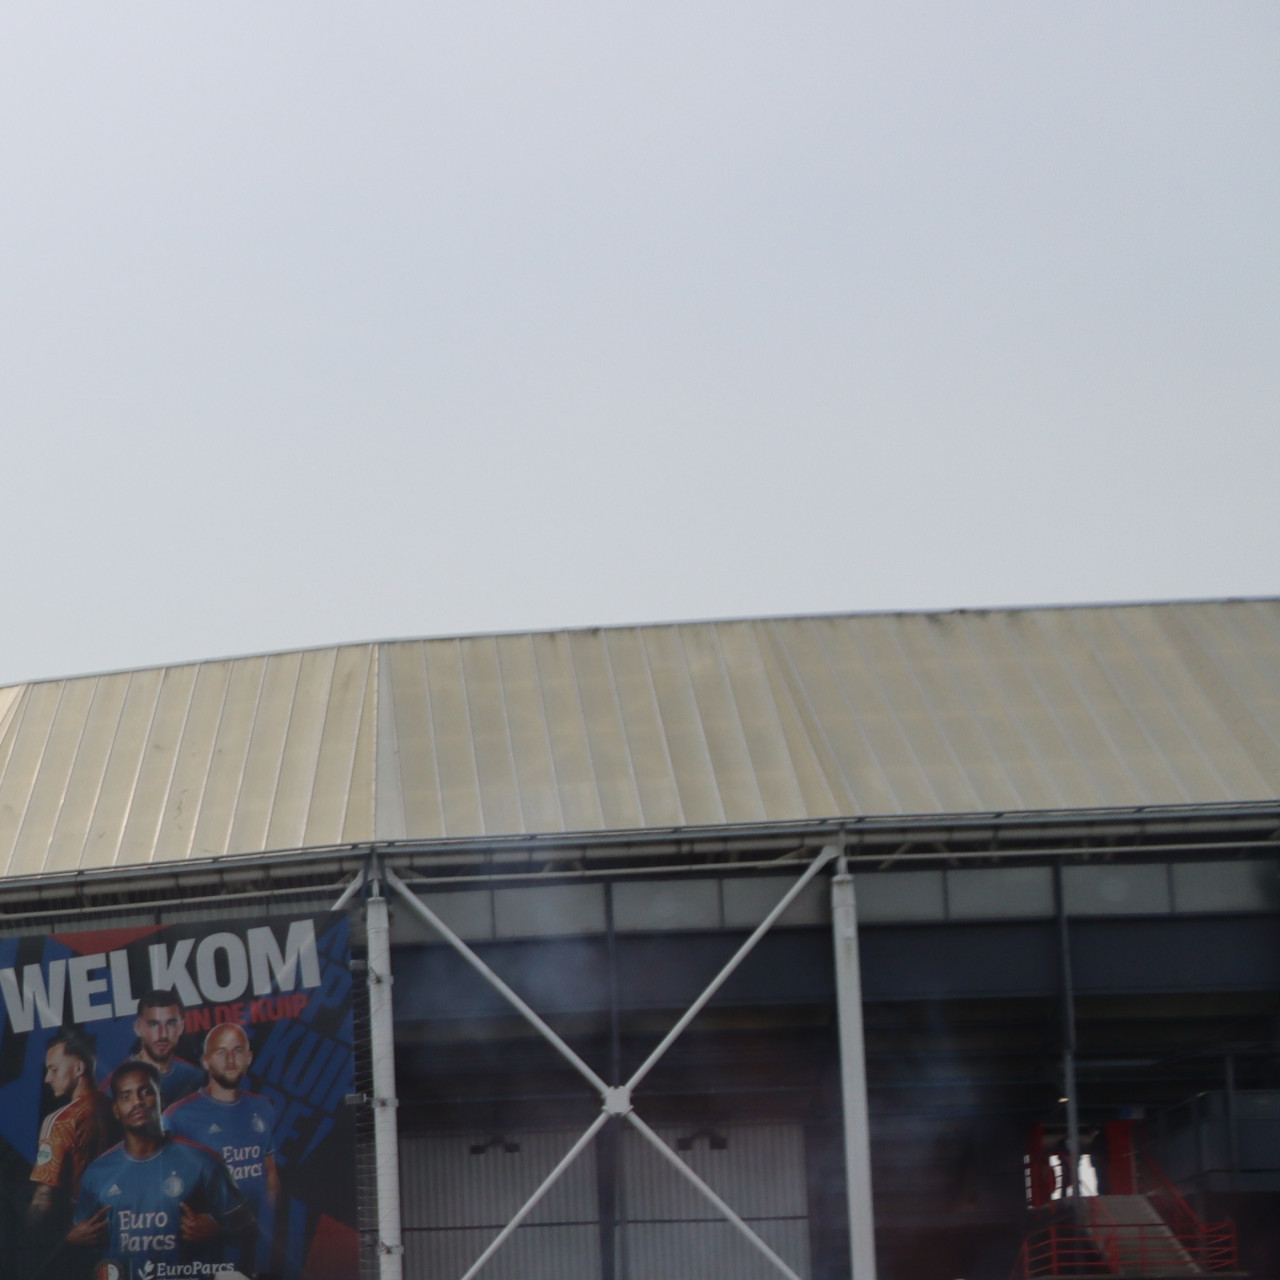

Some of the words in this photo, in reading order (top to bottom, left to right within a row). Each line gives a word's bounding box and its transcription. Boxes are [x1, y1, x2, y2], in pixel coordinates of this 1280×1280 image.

[185, 1010, 211, 1034] IN
[214, 1004, 245, 1026] DE
[251, 994, 308, 1024] KUIP
[223, 1145, 260, 1163] Euro
[118, 1210, 168, 1231] Euro
[120, 1234, 176, 1252] Parcs
[157, 1261, 234, 1277] EuroParcs
